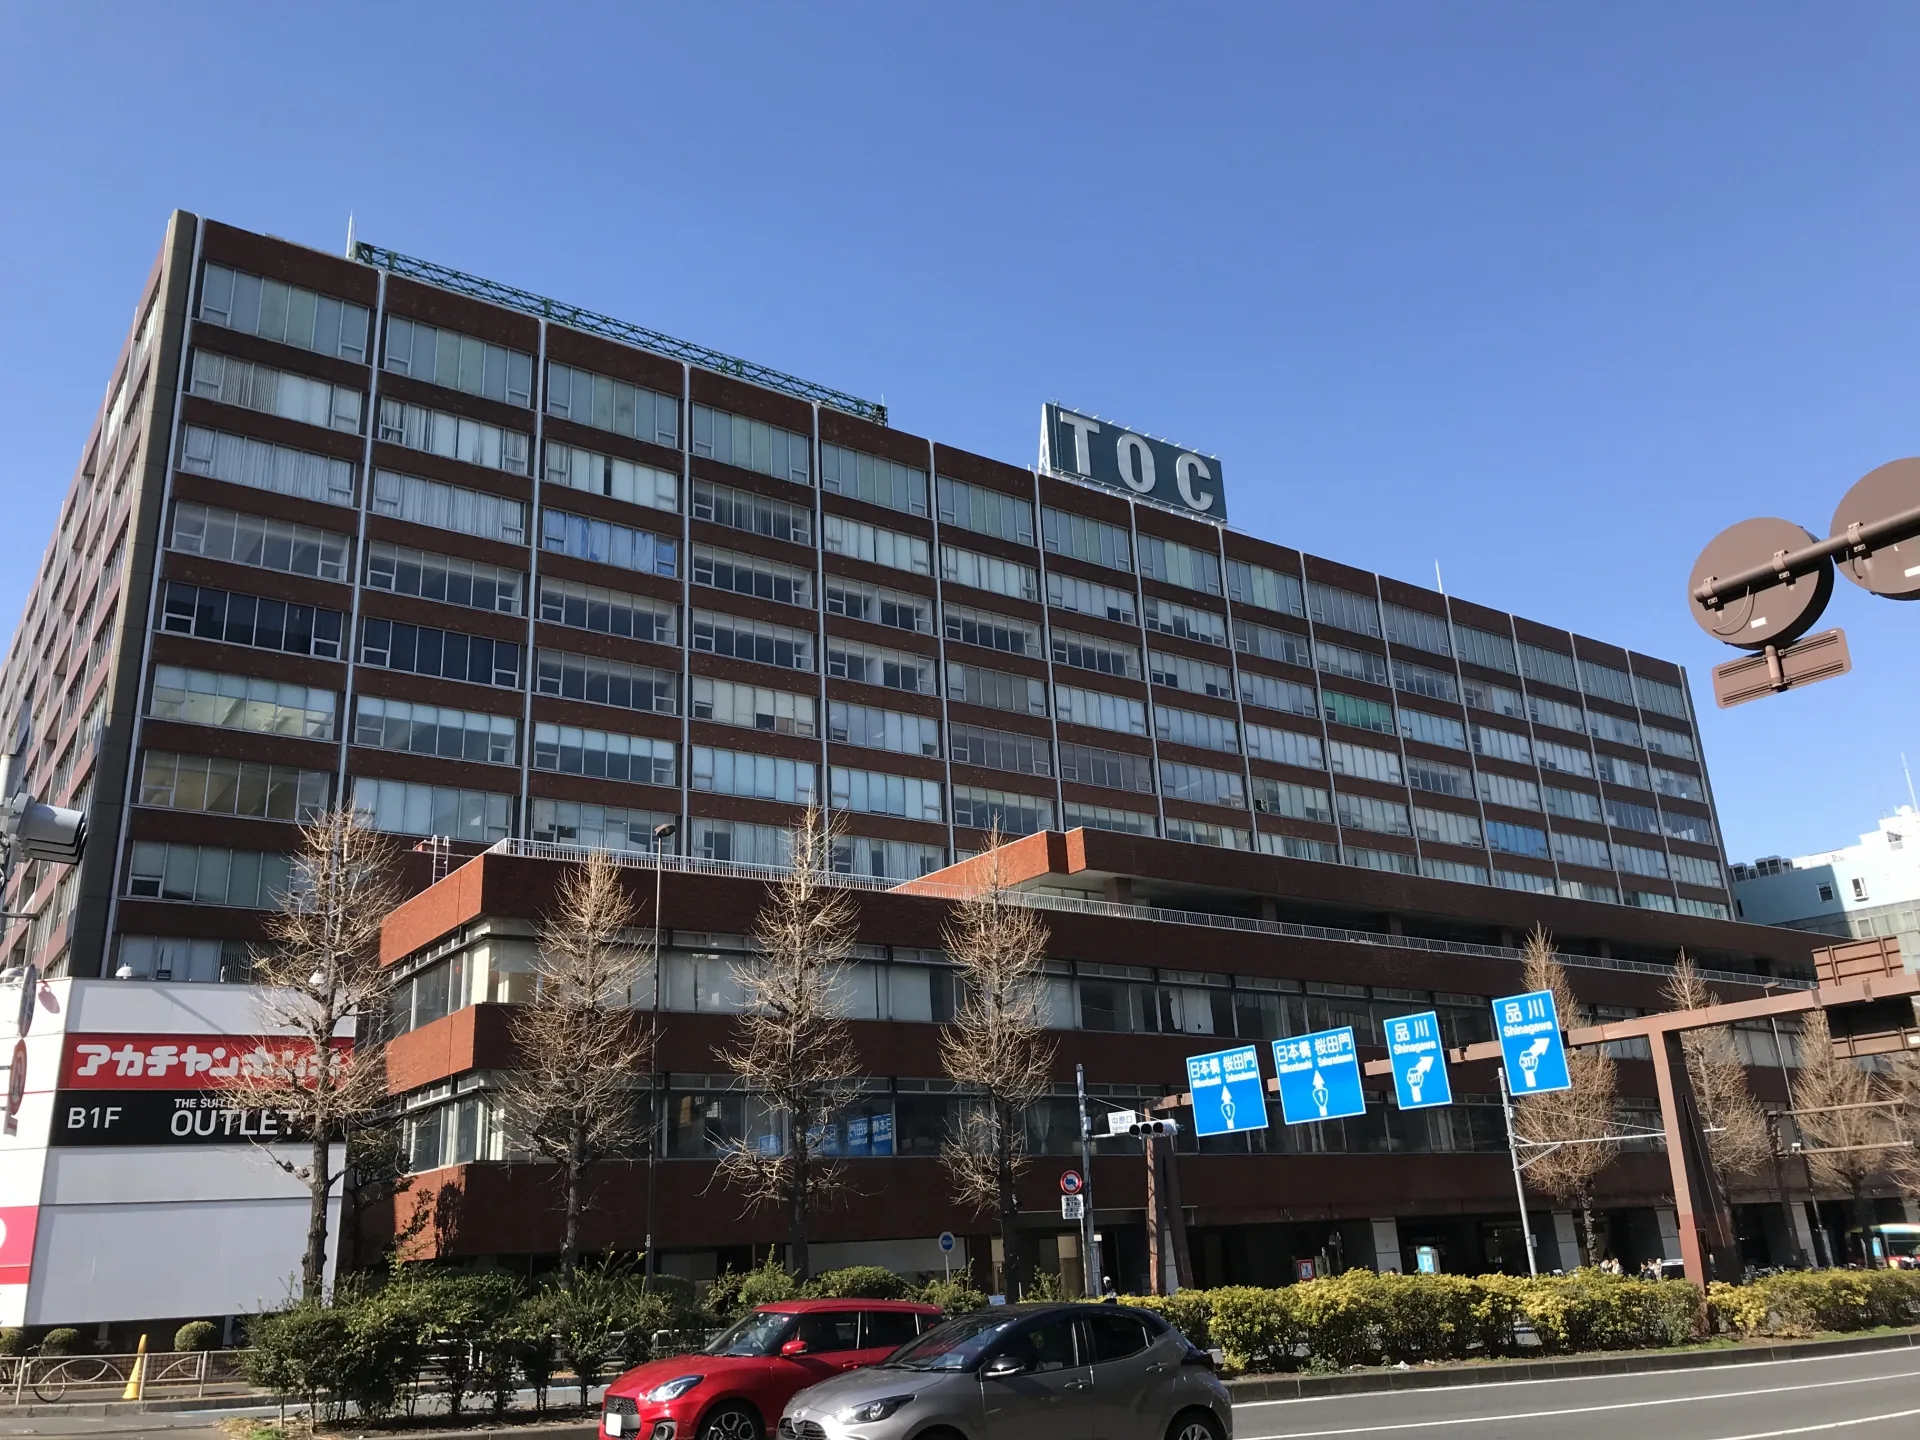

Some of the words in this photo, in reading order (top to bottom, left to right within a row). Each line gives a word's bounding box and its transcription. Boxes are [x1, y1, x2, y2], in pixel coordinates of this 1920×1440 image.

[1060, 411, 1213, 511] TOC
[1505, 997, 1545, 1023] 品川
[1395, 1019, 1430, 1042] 品川
[1503, 1021, 1553, 1037] Shinagawa
[1276, 1040, 1311, 1063] 日本橋
[1315, 1032, 1352, 1055] 桜田門
[1393, 1040, 1436, 1055] Shinagawa
[1190, 1057, 1221, 1078] 日本橋
[1223, 1050, 1256, 1072] 桜田門
[1521, 1055, 1535, 1068] 317
[174, 1099, 198, 1109] THE
[1318, 1091, 1324, 1103] 1
[68, 1107, 122, 1129] B1F
[1226, 1105, 1232, 1116] 1
[171, 1109, 298, 1136] OUTLET
